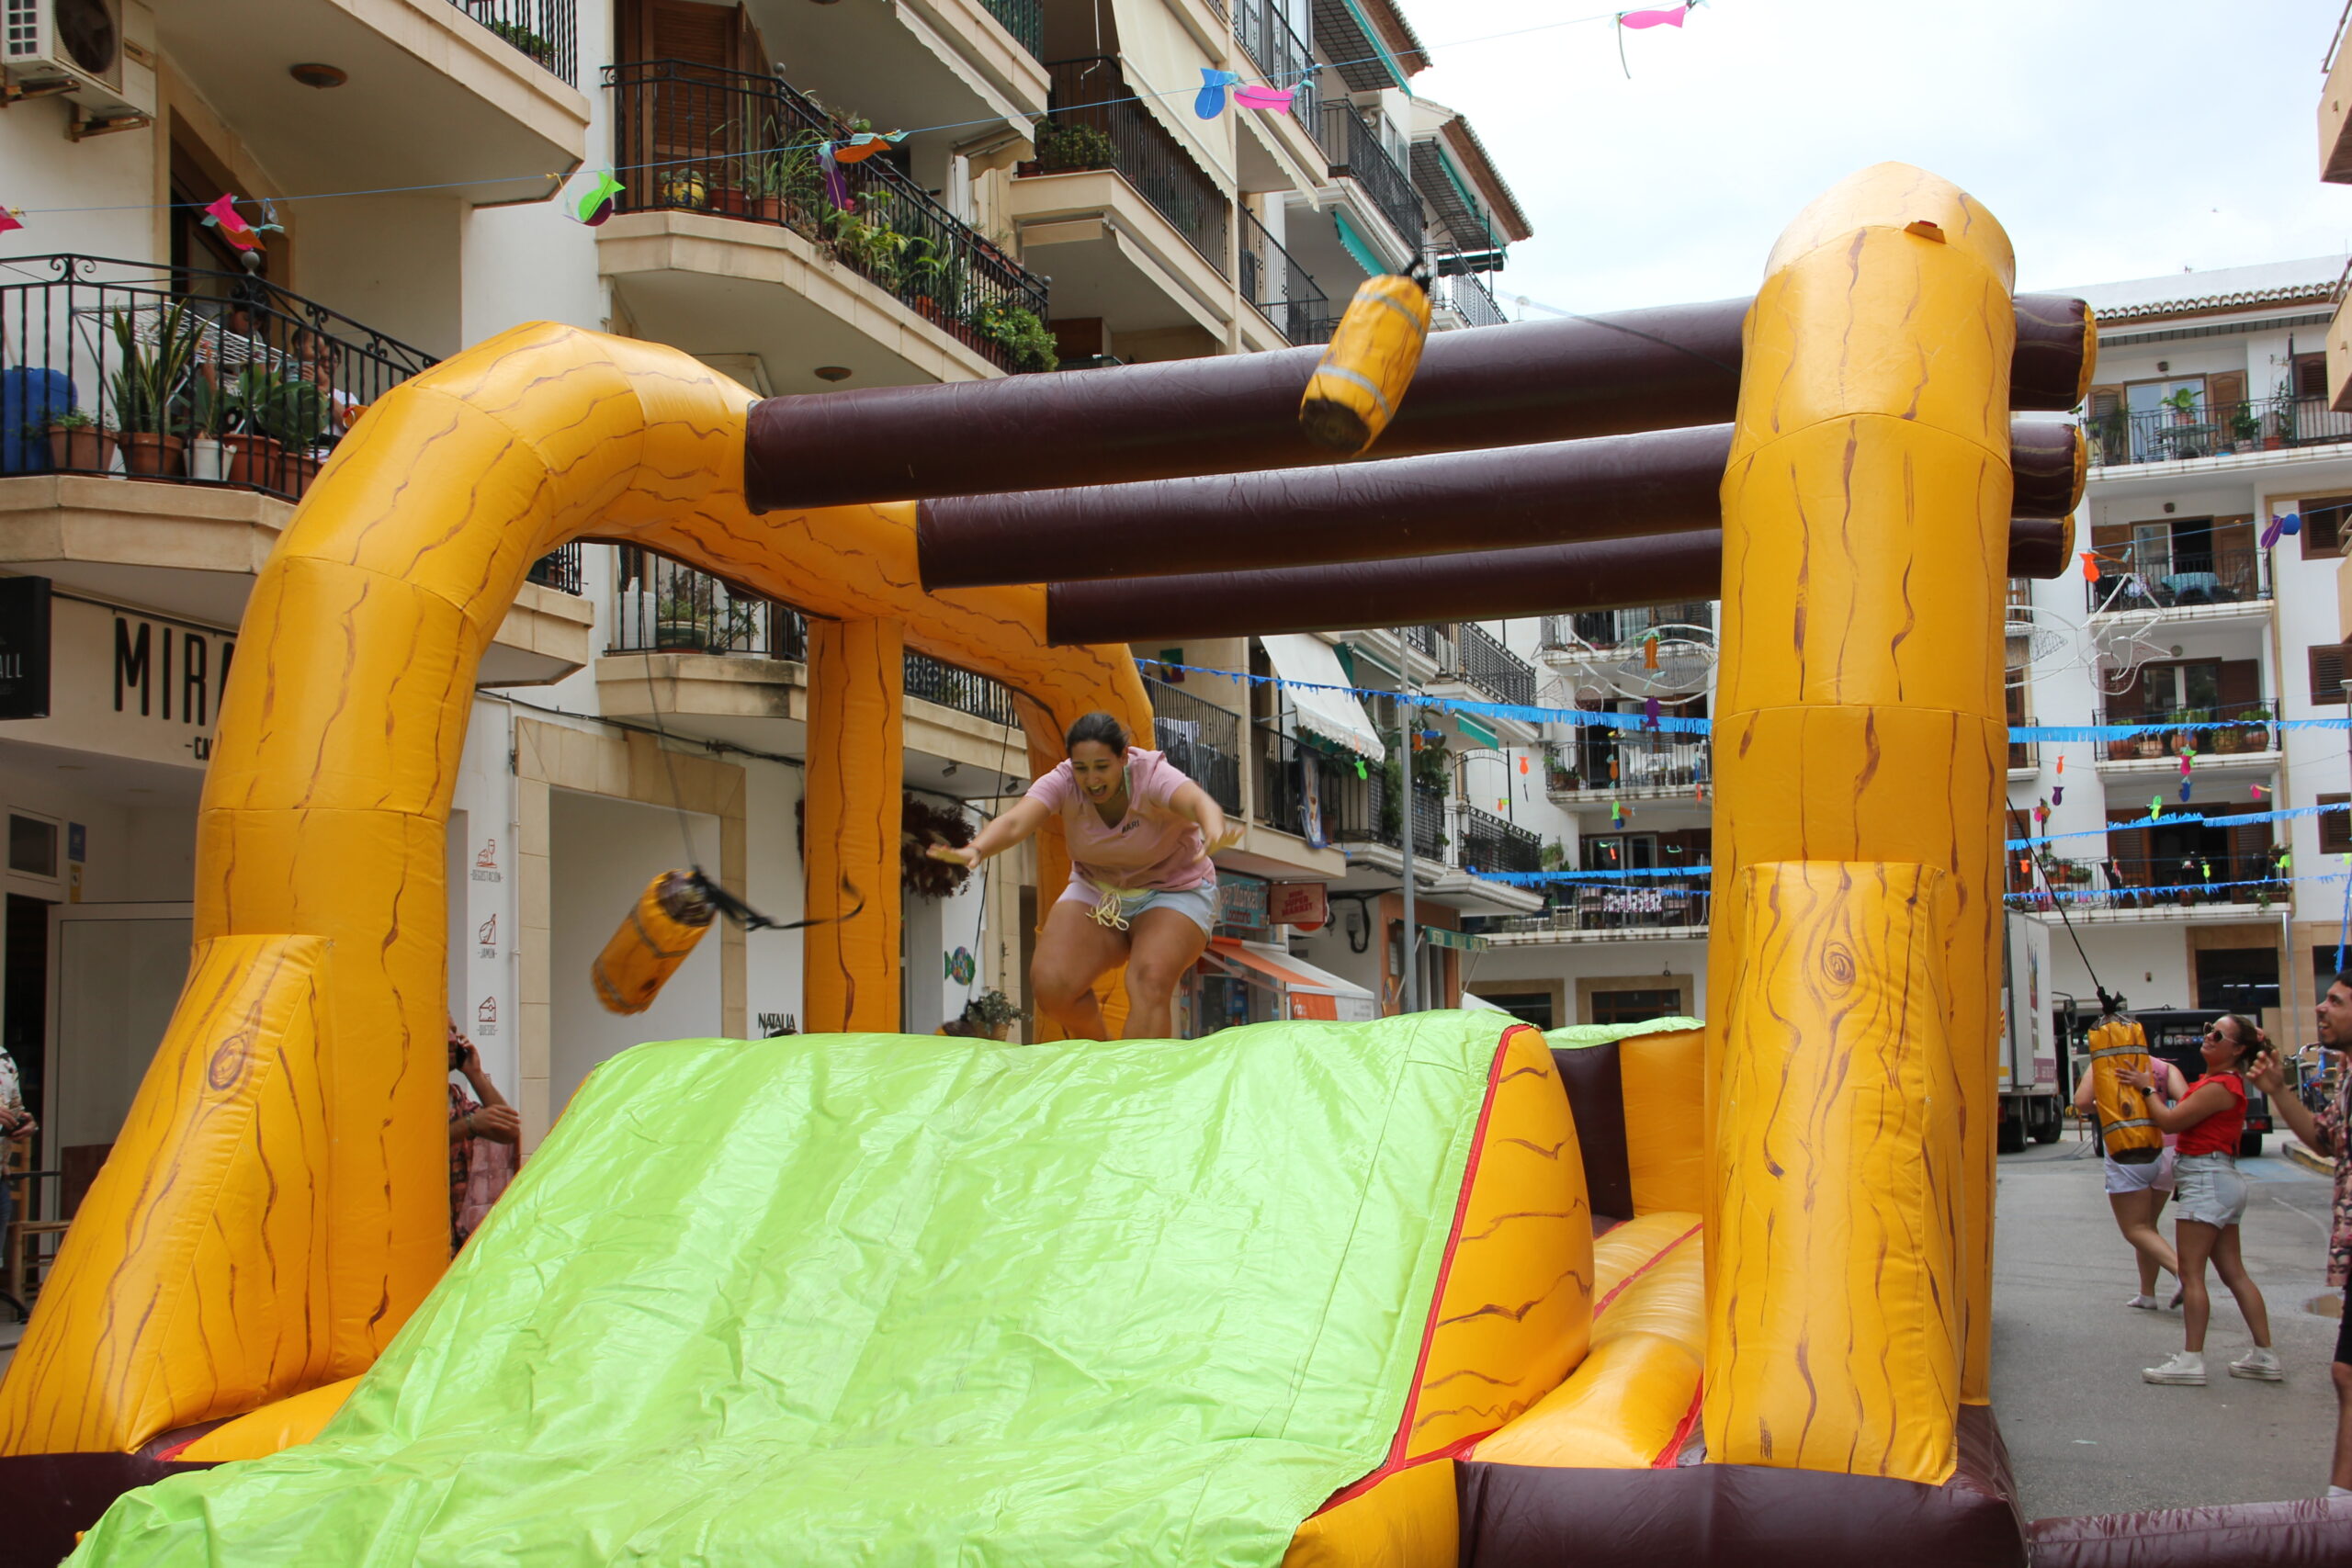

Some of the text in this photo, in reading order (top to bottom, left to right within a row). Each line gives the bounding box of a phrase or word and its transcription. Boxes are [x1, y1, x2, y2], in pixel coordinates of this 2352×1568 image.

[0, 653, 23, 679] LL
[1281, 902, 1314, 917] MARKET
[1284, 895, 1308, 908] SUPER
[758, 1012, 796, 1030] NATALIA
